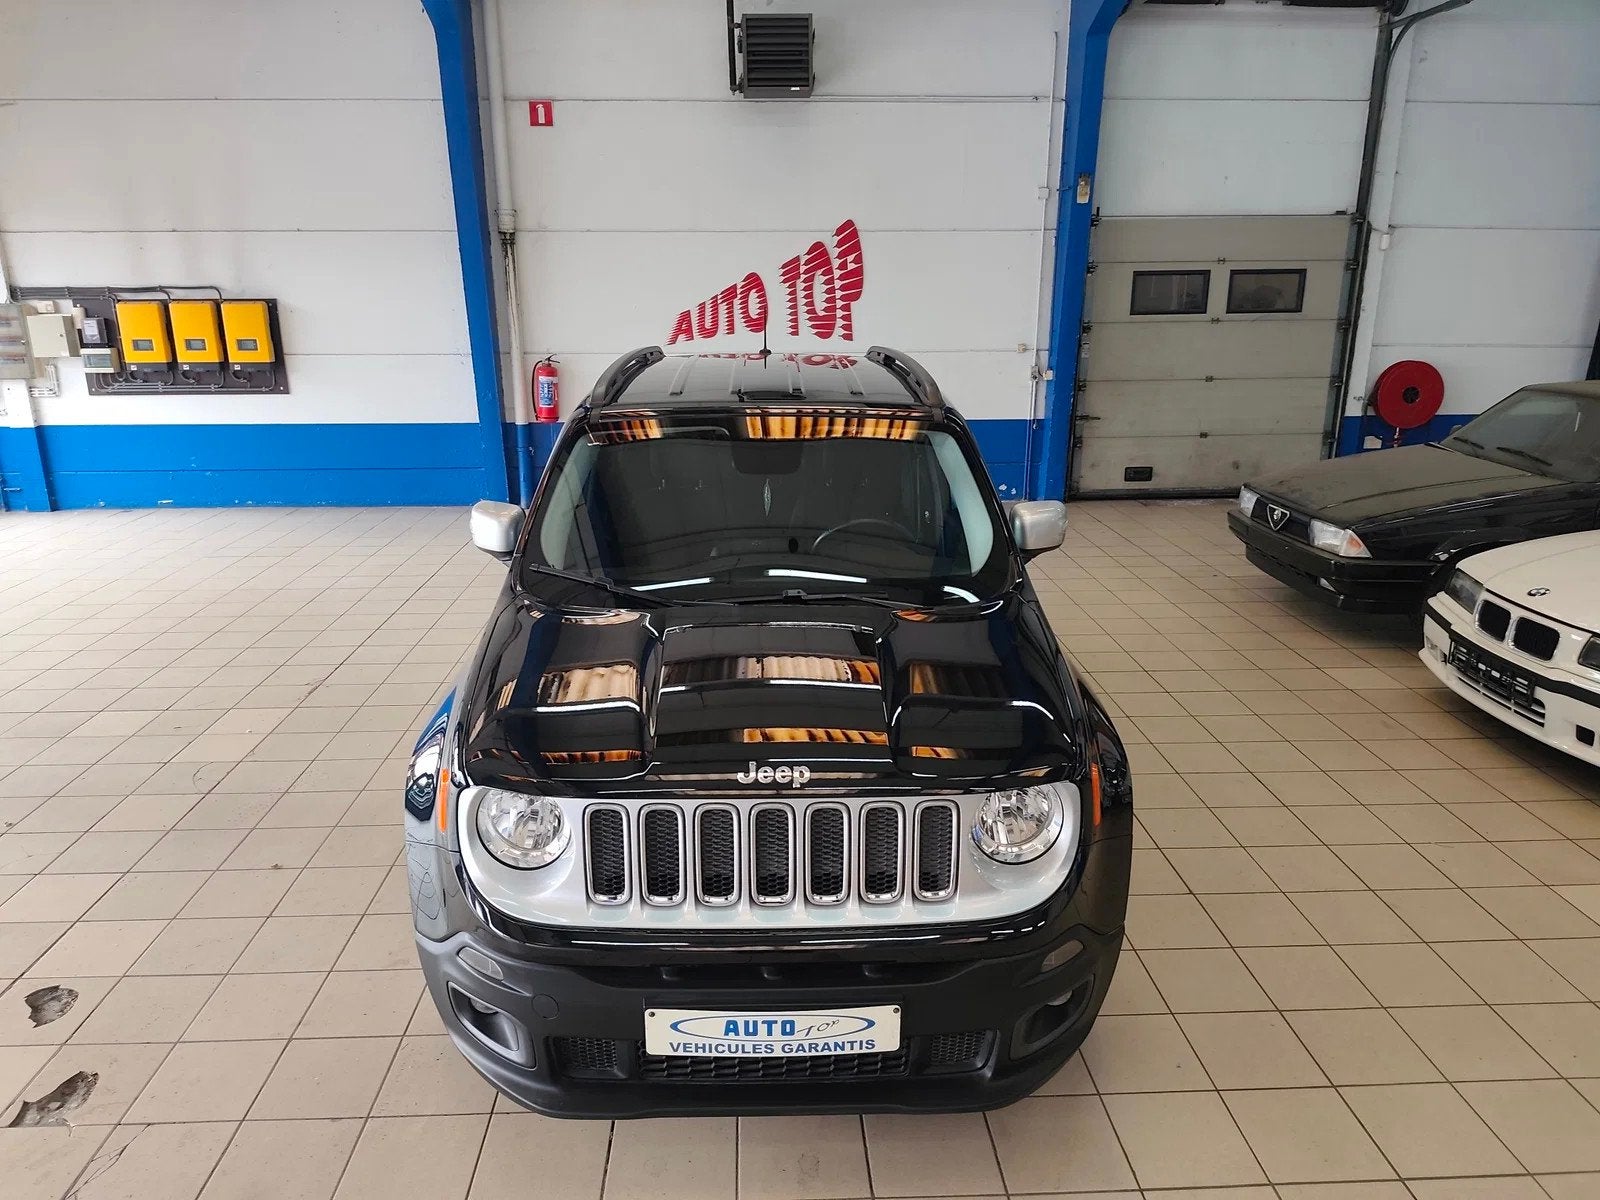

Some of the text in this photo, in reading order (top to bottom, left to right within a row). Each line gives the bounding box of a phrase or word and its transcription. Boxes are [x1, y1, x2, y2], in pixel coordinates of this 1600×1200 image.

[666, 219, 864, 346] AUTO TOP
[736, 761, 811, 788] Jeep
[723, 1019, 796, 1037] AUTO
[669, 1039, 876, 1054] VEHICULES GARANTIS
